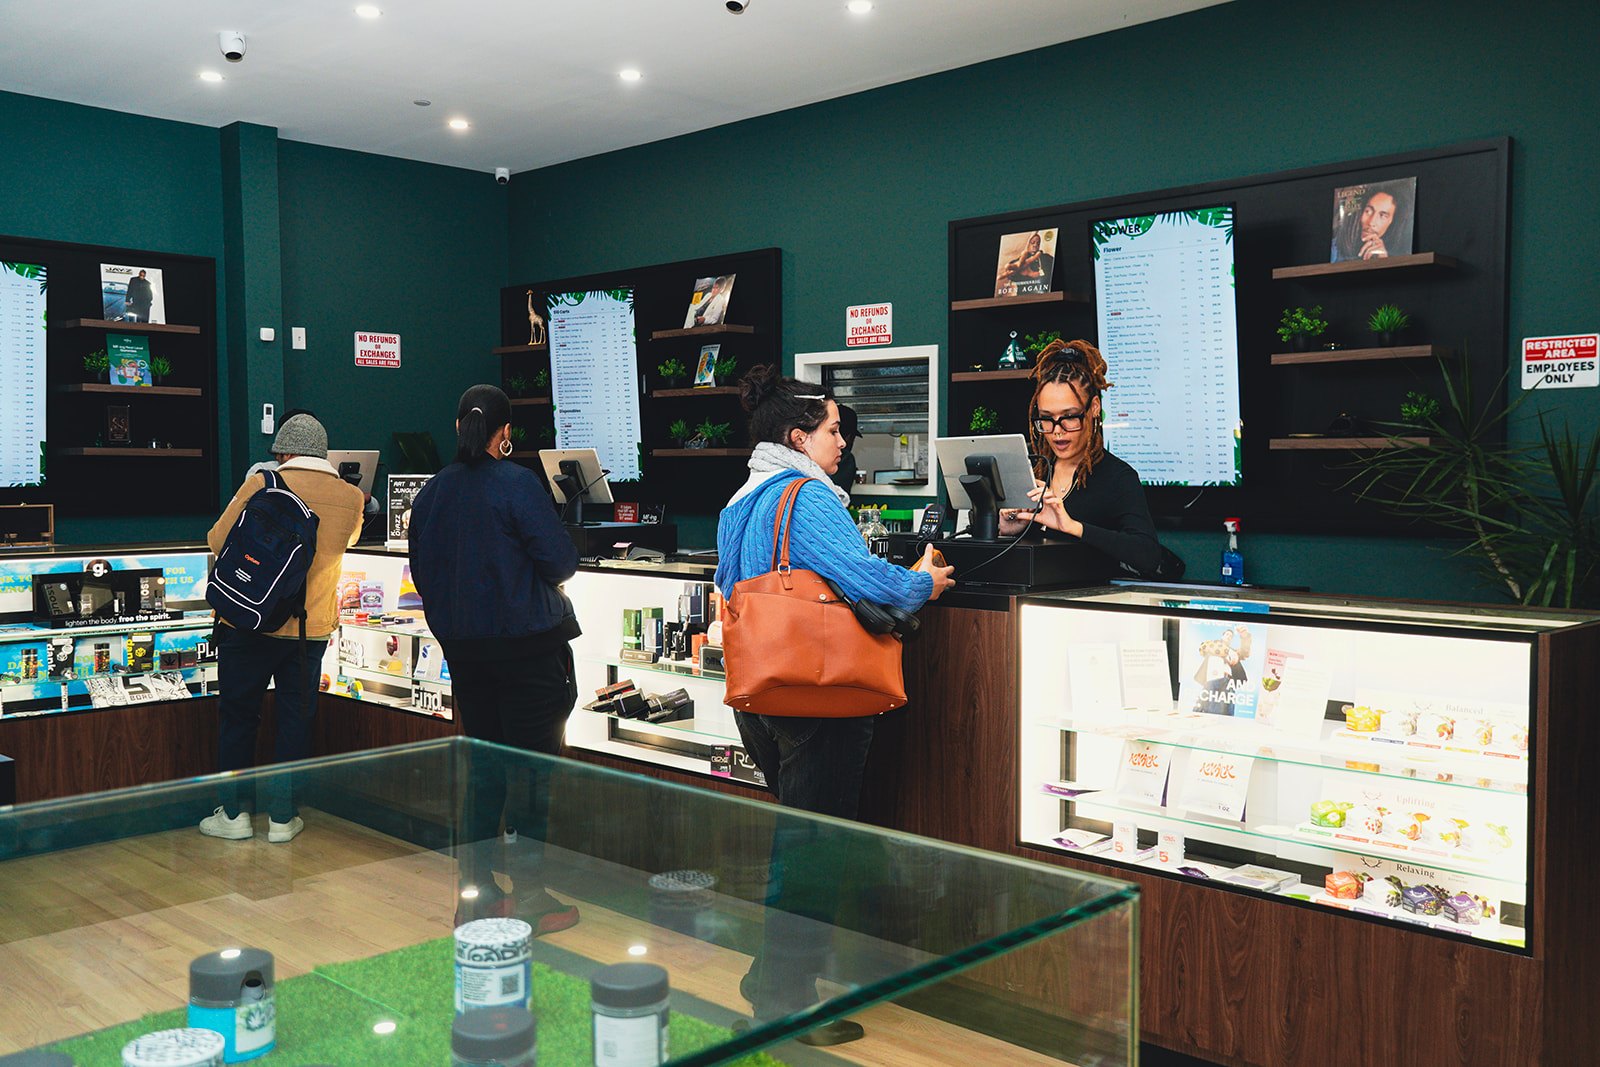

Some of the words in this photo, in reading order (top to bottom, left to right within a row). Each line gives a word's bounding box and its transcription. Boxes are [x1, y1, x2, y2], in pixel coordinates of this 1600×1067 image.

[1099, 224, 1141, 238] FLOWER
[1103, 245, 1122, 253] Flower
[1022, 284, 1049, 292] AGAIN
[850, 309, 859, 318] NO
[860, 306, 888, 317] REFUNDS
[851, 324, 887, 336] EXCHANGES
[369, 335, 397, 344] REFUNDS
[1526, 338, 1596, 350] RESTRICTED
[360, 349, 396, 359] EXCHANGES
[1544, 348, 1576, 359] AREA
[1526, 361, 1595, 374] EMPLOYEES
[1545, 373, 1575, 383] ONLY
[136, 614, 149, 622] the
[1446, 703, 1484, 717] Balanced
[1396, 795, 1436, 809] Uplifting
[1114, 841, 1124, 853] 5
[1158, 851, 1170, 862] 5
[1396, 863, 1436, 879] Relaxing
